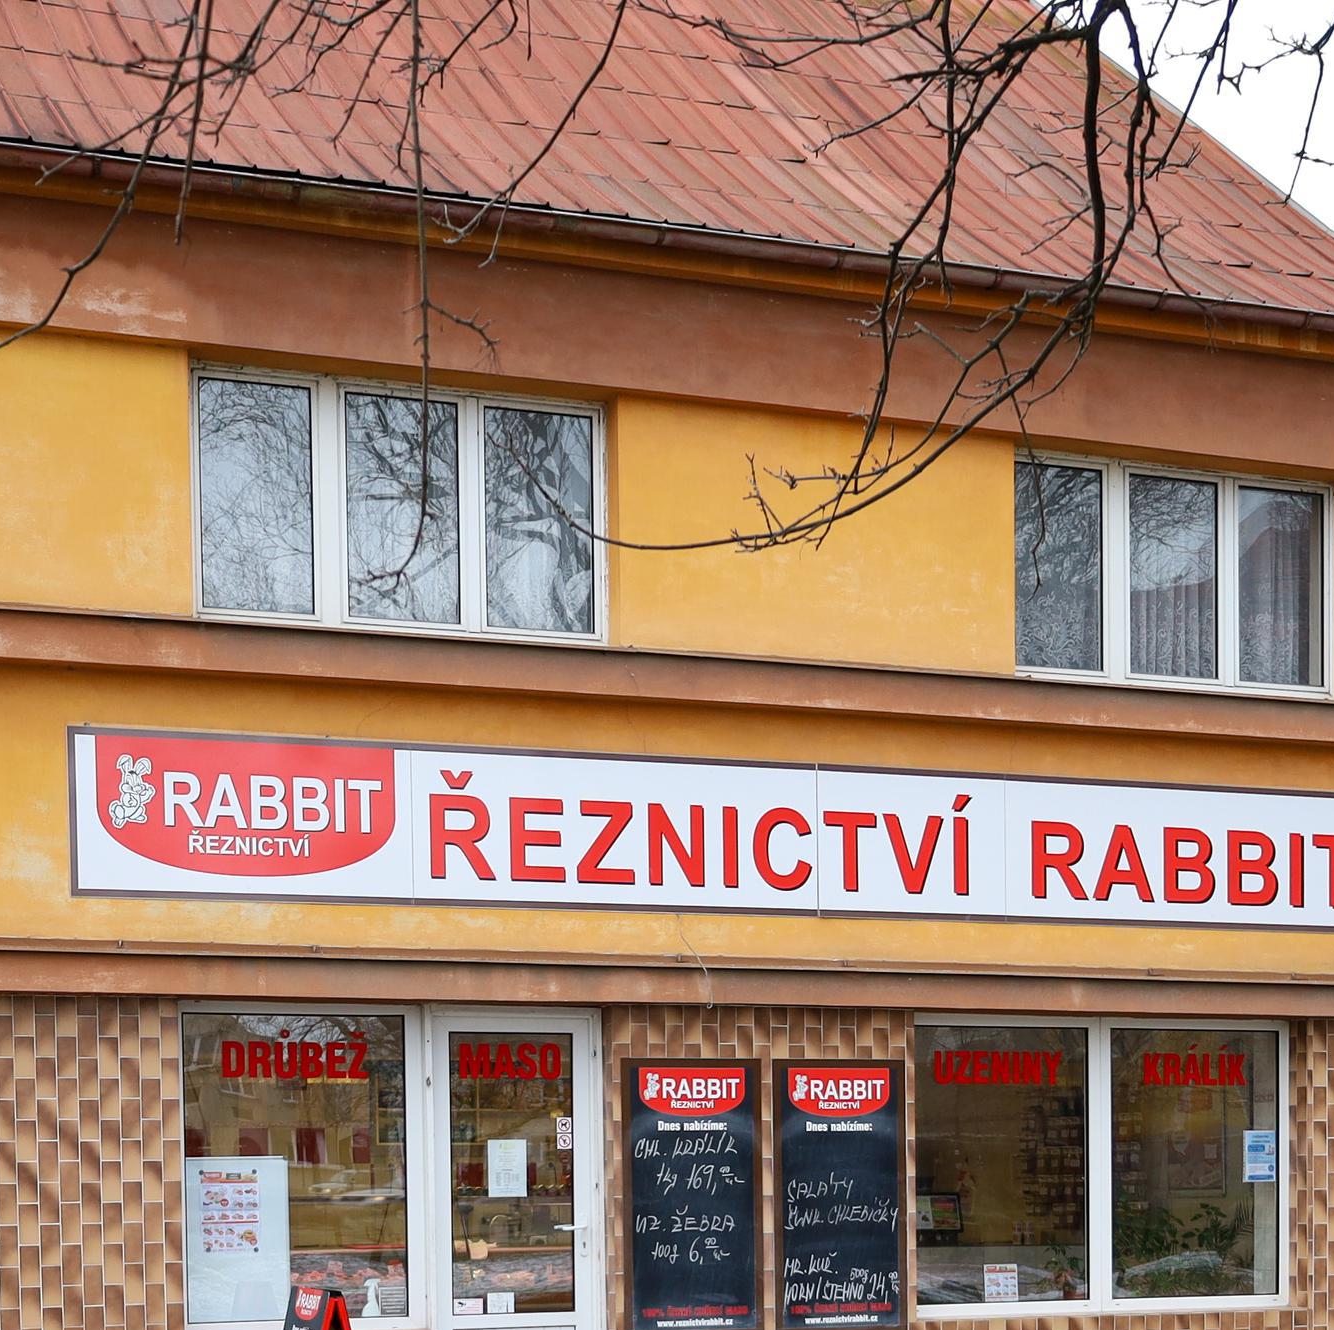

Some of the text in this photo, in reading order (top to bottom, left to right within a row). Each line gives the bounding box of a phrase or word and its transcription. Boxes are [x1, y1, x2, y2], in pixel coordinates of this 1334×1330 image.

[163, 771, 383, 835] RABBIT
[188, 830, 311, 858] ŘEZNICTVÍ
[429, 770, 972, 896] ŘEZNICTVÍ
[221, 1029, 371, 1080] DRŮBEŽ
[458, 1043, 562, 1081] MASO
[934, 1050, 1063, 1086] UZENINY
[1143, 1044, 1247, 1087] KRÁLÍK
[662, 1078, 740, 1099] RABBIT
[810, 1079, 885, 1100] RABBIT
[670, 1099, 714, 1109] ŘEZNICTVÍ
[818, 1100, 860, 1110] ŘEZNICTVÍ
[657, 1119, 728, 1131] Dnes nabízíme:
[805, 1120, 873, 1132] Dnes nabízíme:
